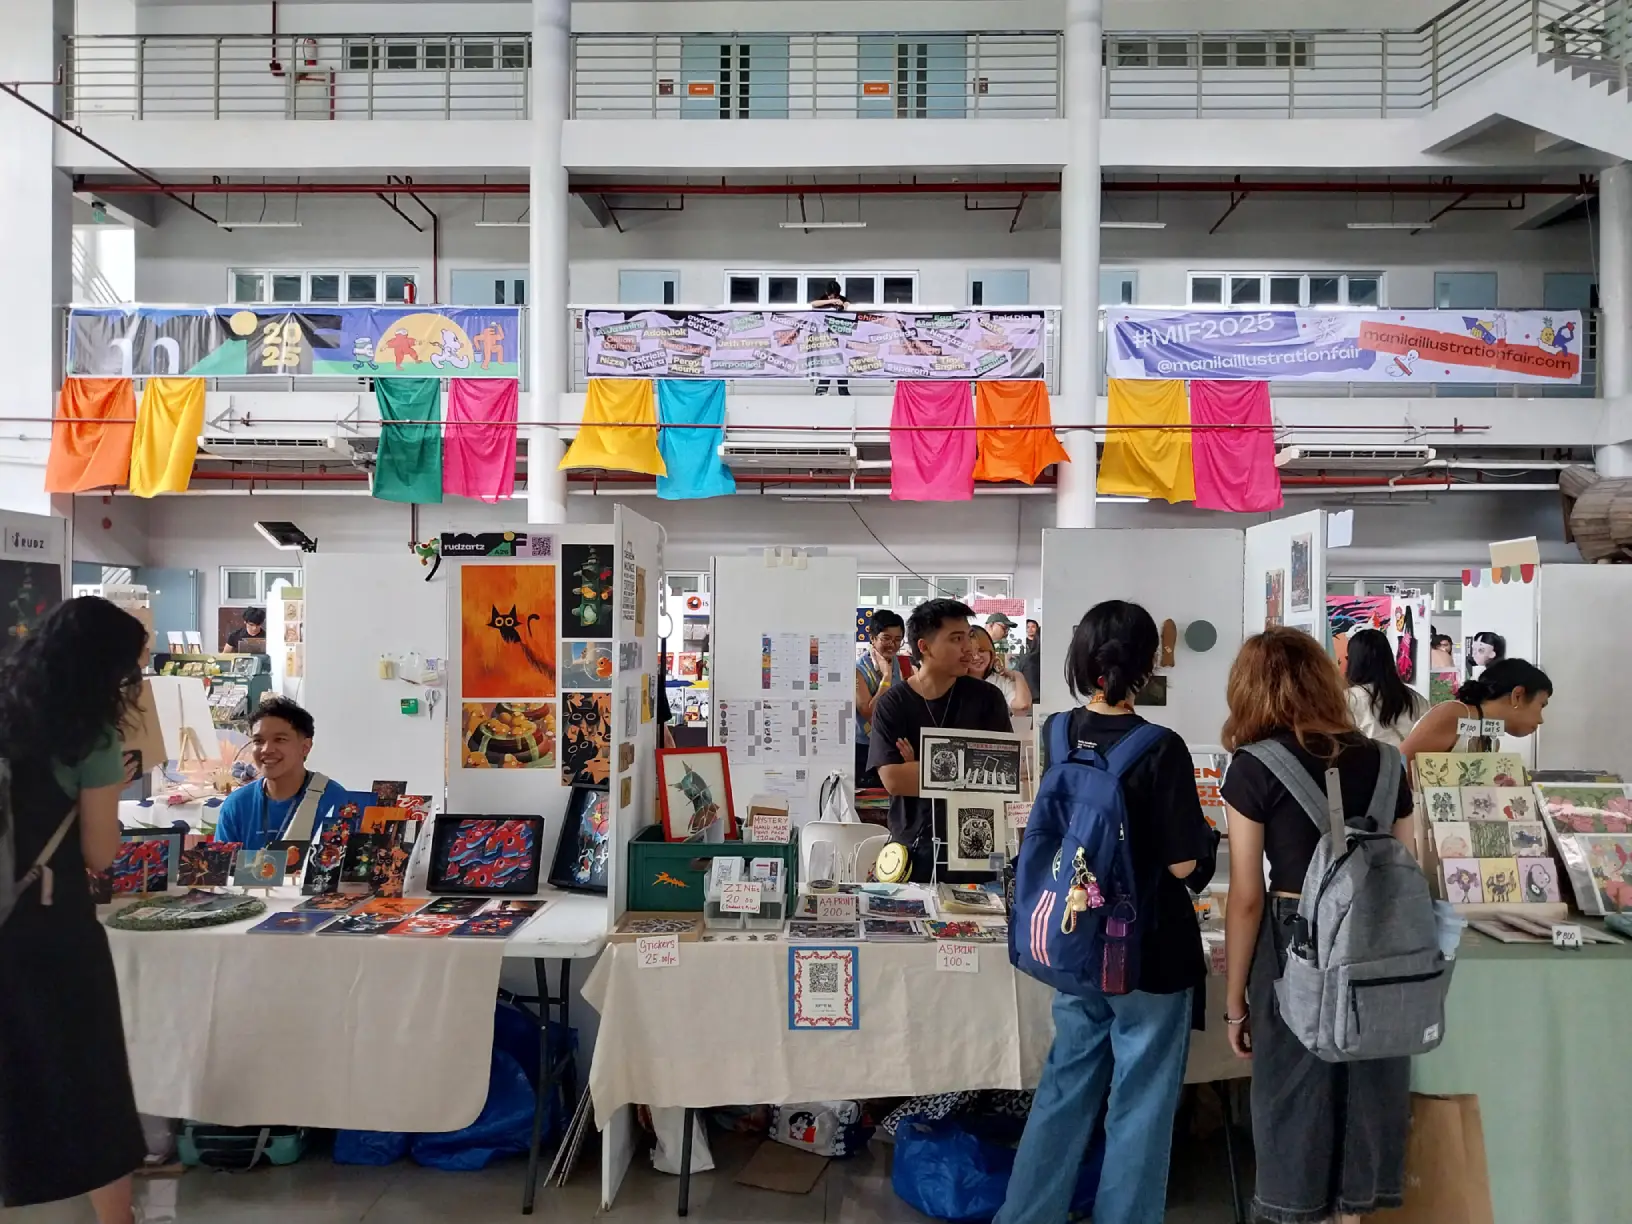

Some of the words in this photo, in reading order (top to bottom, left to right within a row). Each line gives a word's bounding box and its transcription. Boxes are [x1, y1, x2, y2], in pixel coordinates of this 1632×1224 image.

[1131, 312, 1276, 350] #MIF2025
[1157, 346, 1363, 374] @manilaillustrationfair
[1363, 329, 1572, 371] manilaillustrationfair.com
[444, 543, 485, 551] rudzartz
[754, 816, 788, 824] MYSTERY
